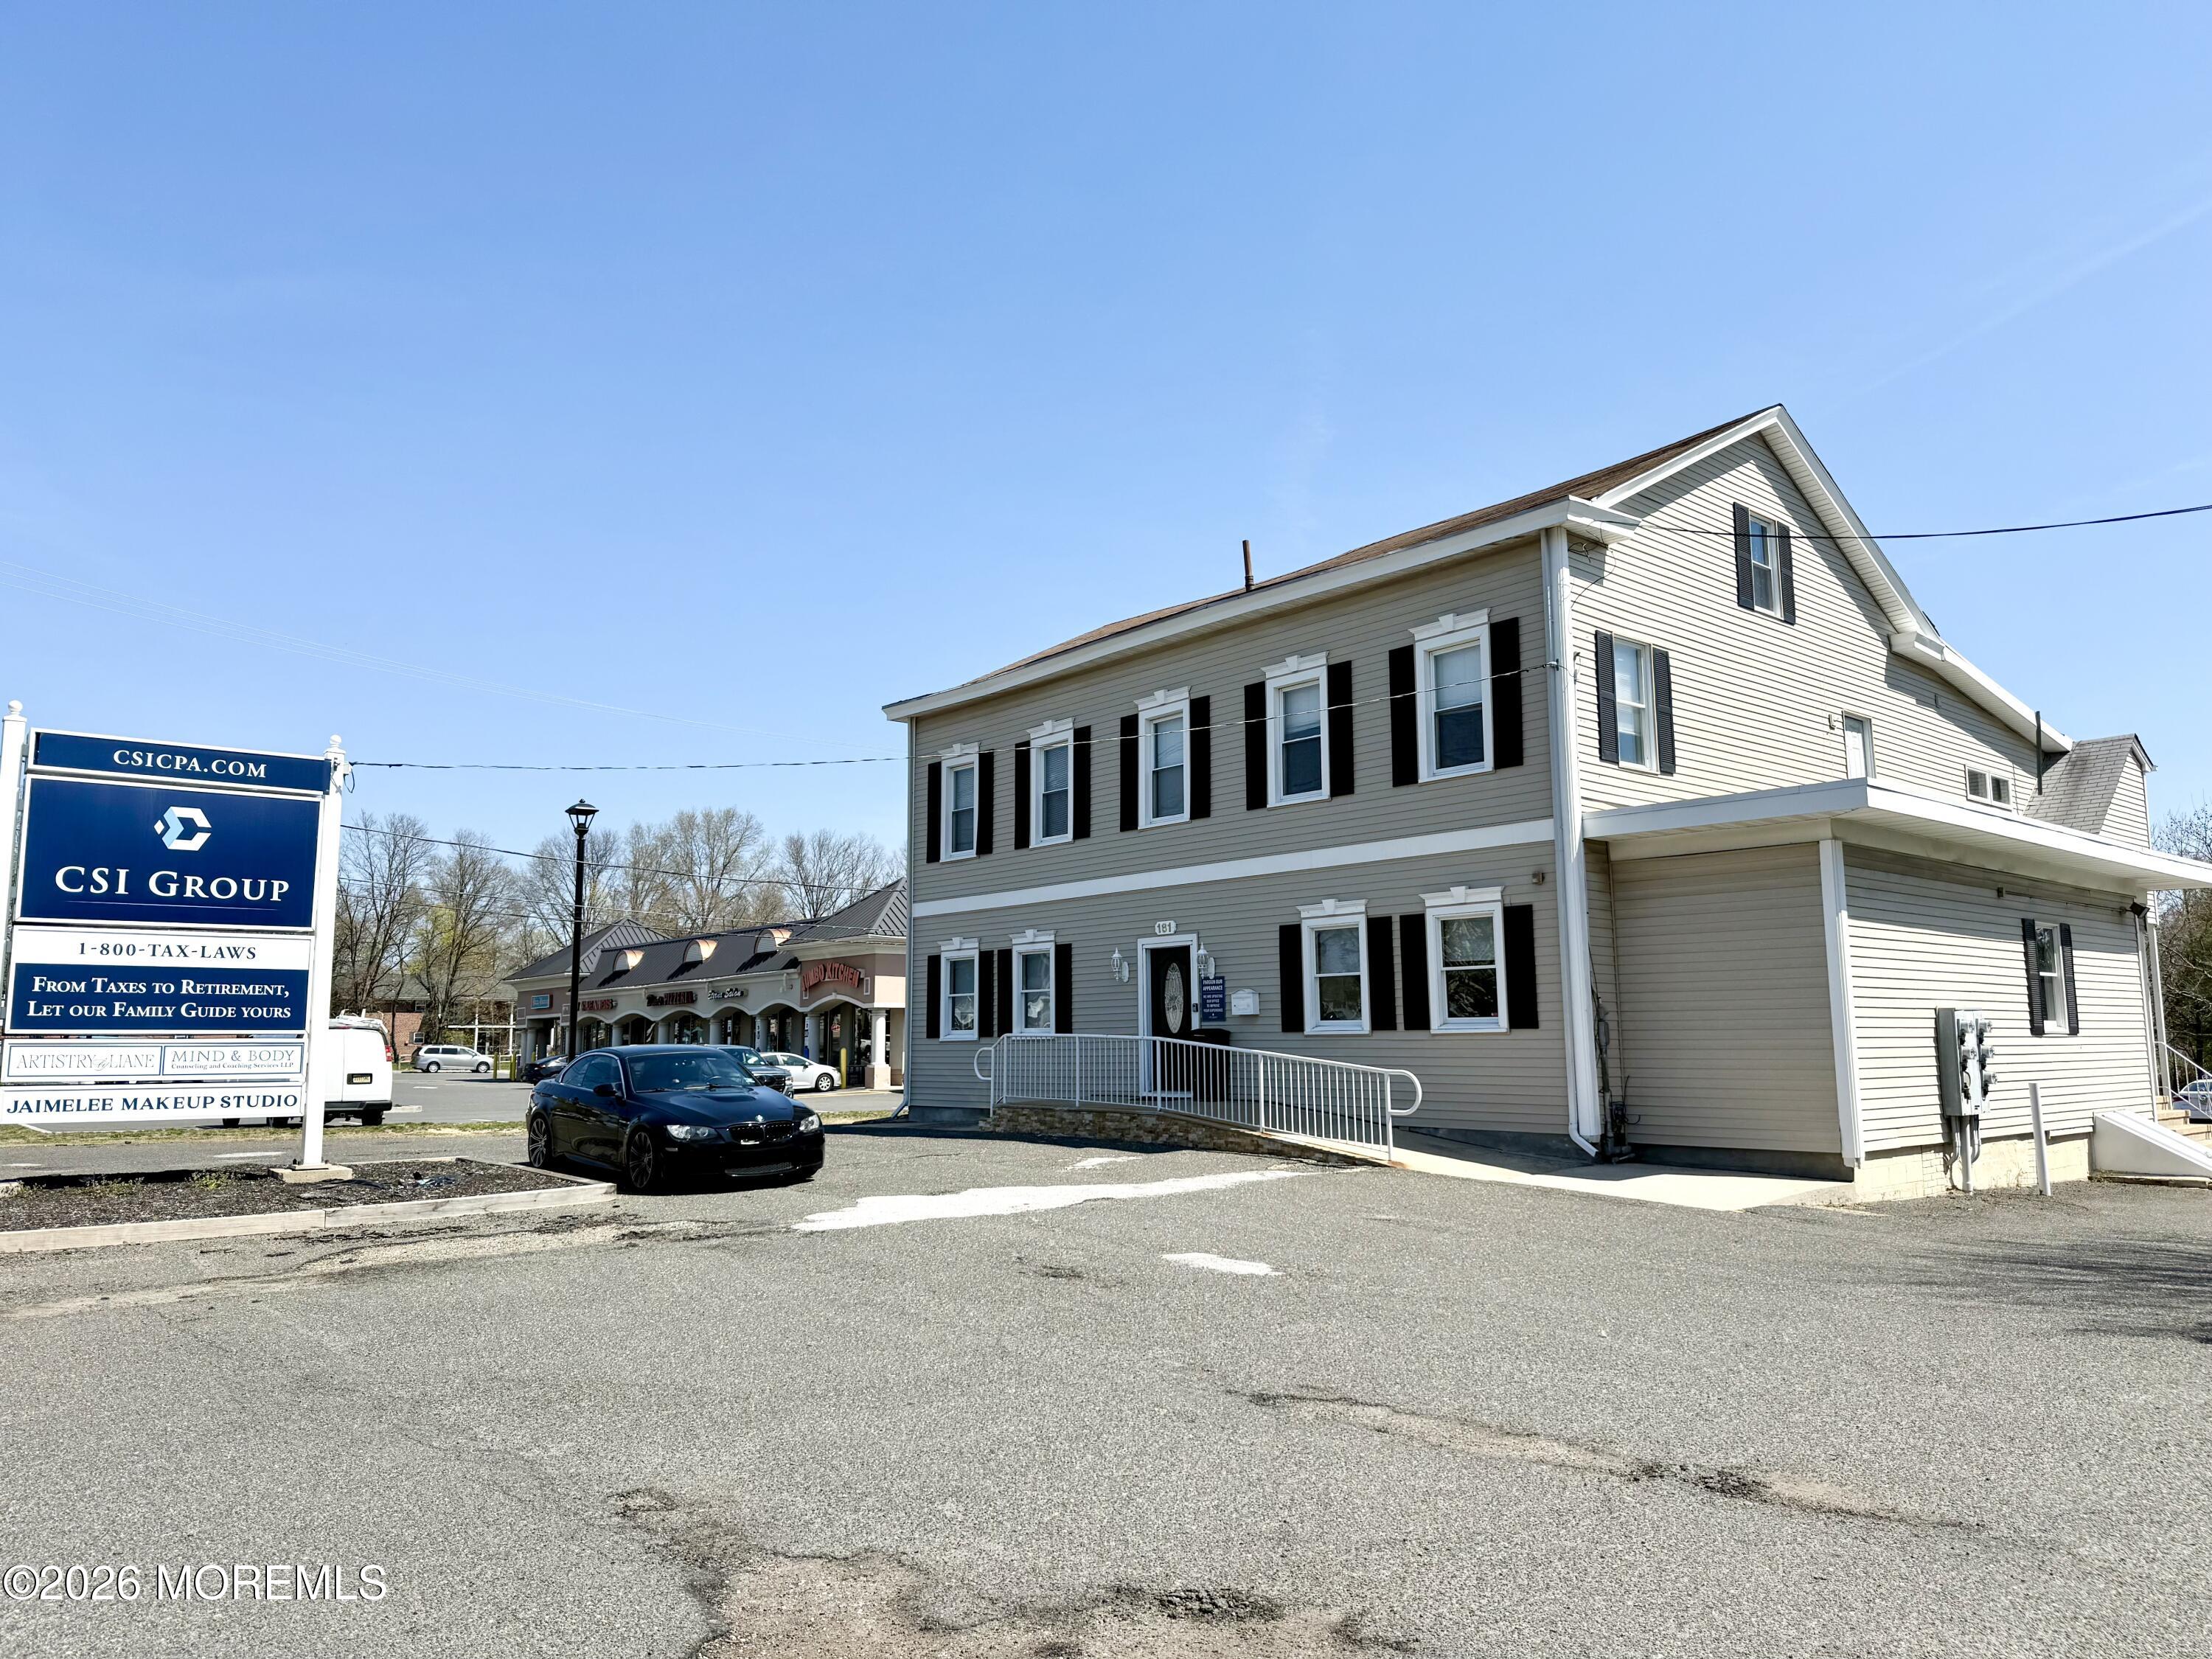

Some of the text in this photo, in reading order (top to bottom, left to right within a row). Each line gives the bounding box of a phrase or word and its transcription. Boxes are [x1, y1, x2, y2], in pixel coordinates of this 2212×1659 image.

[113, 749, 267, 778] CSICPA.COM
[55, 866, 290, 902] CSI GROUP
[1157, 922, 1171, 933] 181
[79, 942, 257, 959] 1-800-TAX-LAWS
[802, 961, 860, 991] JUMBO KITCHEN
[32, 977, 290, 998] FROM TAXES TO RETIREMENT,
[27, 1001, 291, 1019] LET OUR FAMILY GUIDE YOURS
[16, 1054, 96, 1068] ARTISTRY
[109, 1054, 155, 1068] LIANE
[172, 1050, 294, 1062] MIND & BODY
[7, 1094, 298, 1114] JAIMELEE MAKEUP STUDIO
